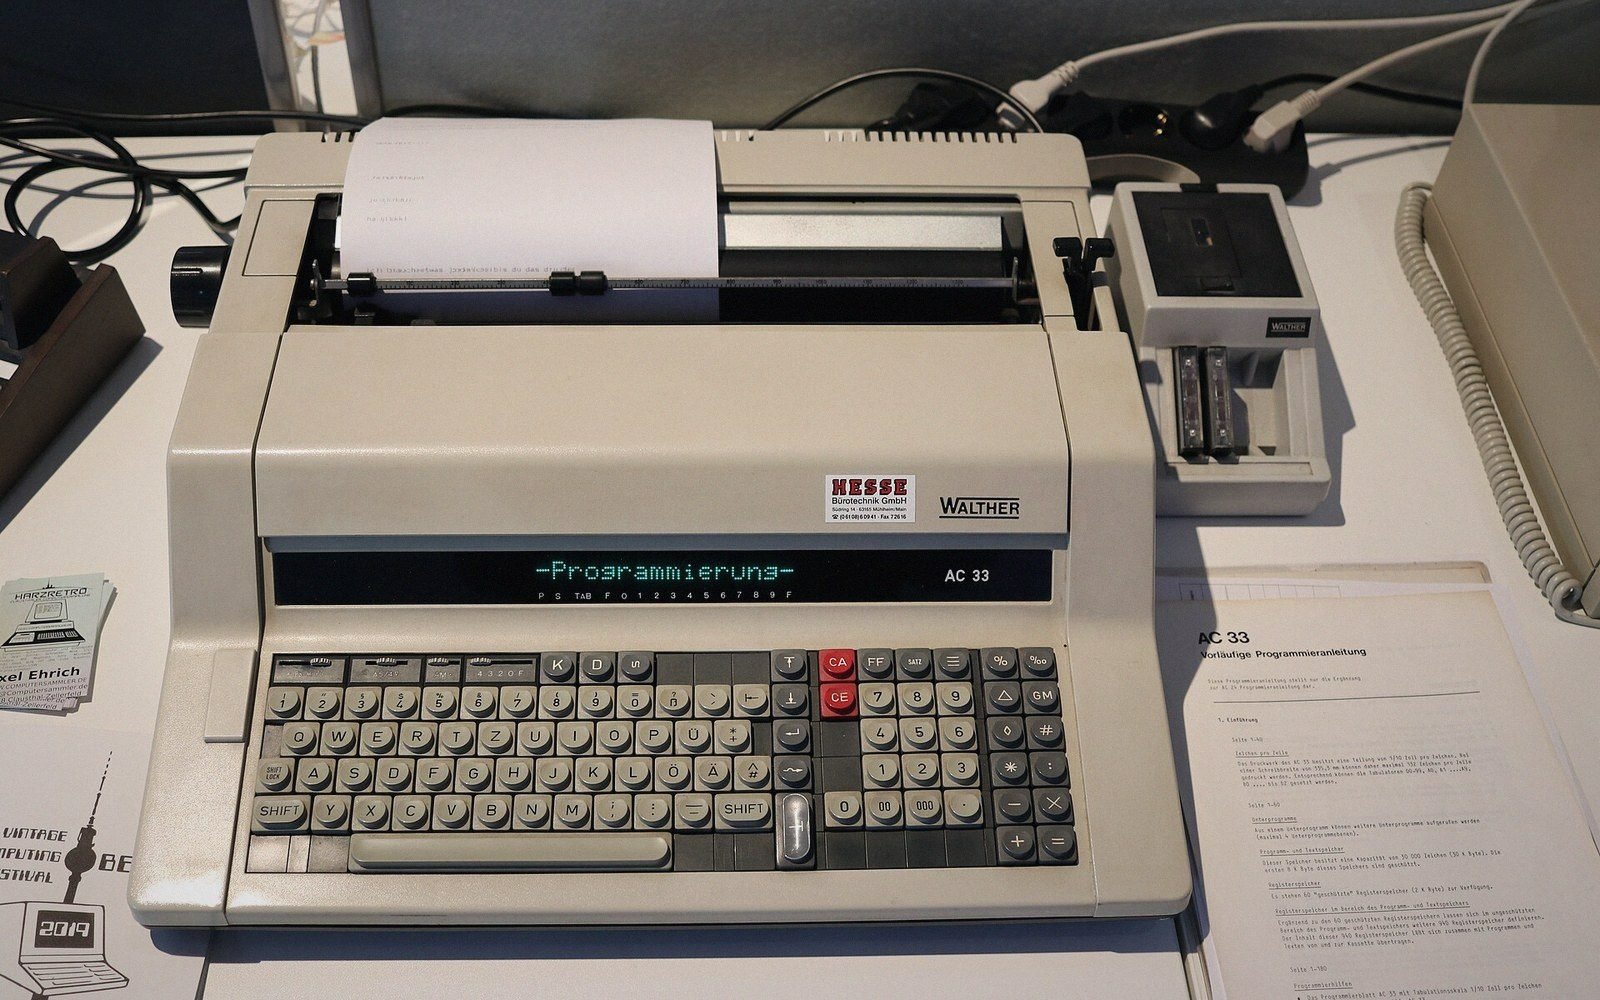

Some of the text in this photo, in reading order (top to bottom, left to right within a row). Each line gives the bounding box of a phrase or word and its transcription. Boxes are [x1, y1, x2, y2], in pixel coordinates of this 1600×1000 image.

[1272, 321, 1306, 331] WALTHER
[832, 479, 907, 495] HESSE
[939, 496, 1019, 515] WALTHER
[944, 569, 990, 582] AC 33
[15, 587, 87, 600] HARZRETRO
[1198, 631, 1250, 644] AC 33
[1201, 648, 1367, 660] Vorläufige Programmieranleitung
[552, 660, 563, 670] K
[592, 660, 602, 670] D
[830, 658, 846, 667] CA
[868, 658, 884, 666] FF
[994, 656, 1007, 666] %
[29, 667, 80, 680] Ehrich
[832, 692, 848, 702] CE
[874, 692, 882, 702] 7
[914, 692, 922, 702] 8
[952, 692, 960, 702] 9
[1033, 692, 1053, 700] GM
[280, 700, 285, 709] 1
[318, 700, 325, 708] 2
[358, 700, 364, 708] 3
[396, 700, 404, 708] 4
[436, 699, 442, 708] 5
[475, 699, 482, 708] 6
[514, 699, 522, 707] 7
[553, 698, 560, 707] 8
[592, 698, 599, 707] 9
[632, 698, 638, 707] 0
[573, 730, 576, 742] I
[610, 730, 620, 741] O
[650, 730, 659, 740] P
[688, 728, 698, 741] Ü
[876, 728, 885, 738] 4
[916, 727, 923, 738] 5
[956, 727, 964, 738] 6
[1040, 725, 1053, 736] #
[294, 732, 304, 743] Q
[332, 731, 346, 742] W
[373, 732, 384, 742] E
[412, 731, 422, 742] R
[453, 731, 461, 742] T
[490, 731, 501, 742] Z
[530, 731, 540, 742] U
[350, 768, 359, 778] S
[388, 768, 399, 778] D
[429, 768, 439, 778] F
[508, 767, 518, 778] H
[588, 767, 598, 778] K
[630, 767, 637, 778] L
[668, 764, 679, 778] Ö
[708, 763, 718, 777] Ä
[879, 764, 885, 774] 1
[918, 764, 927, 774] 2
[958, 762, 966, 773] 3
[308, 768, 319, 779] A
[468, 768, 479, 779] G
[549, 768, 557, 779] J
[260, 805, 299, 816] SHIFT
[326, 804, 335, 816] Y
[366, 805, 375, 816] X
[406, 806, 416, 816] C
[446, 804, 456, 816] V
[487, 804, 497, 816] B
[527, 804, 537, 815] N
[566, 805, 578, 816] M
[724, 804, 764, 814] SHIFT
[840, 801, 849, 812] 0
[879, 802, 890, 812] 00
[916, 800, 934, 811] 000
[3, 827, 68, 842] VINTAGE
[1268, 881, 1321, 889] Registerspeicher
[1275, 906, 1328, 915] Registerspeicher
[39, 921, 90, 938] 2019
[1294, 981, 1352, 989] Programmierhilfen
